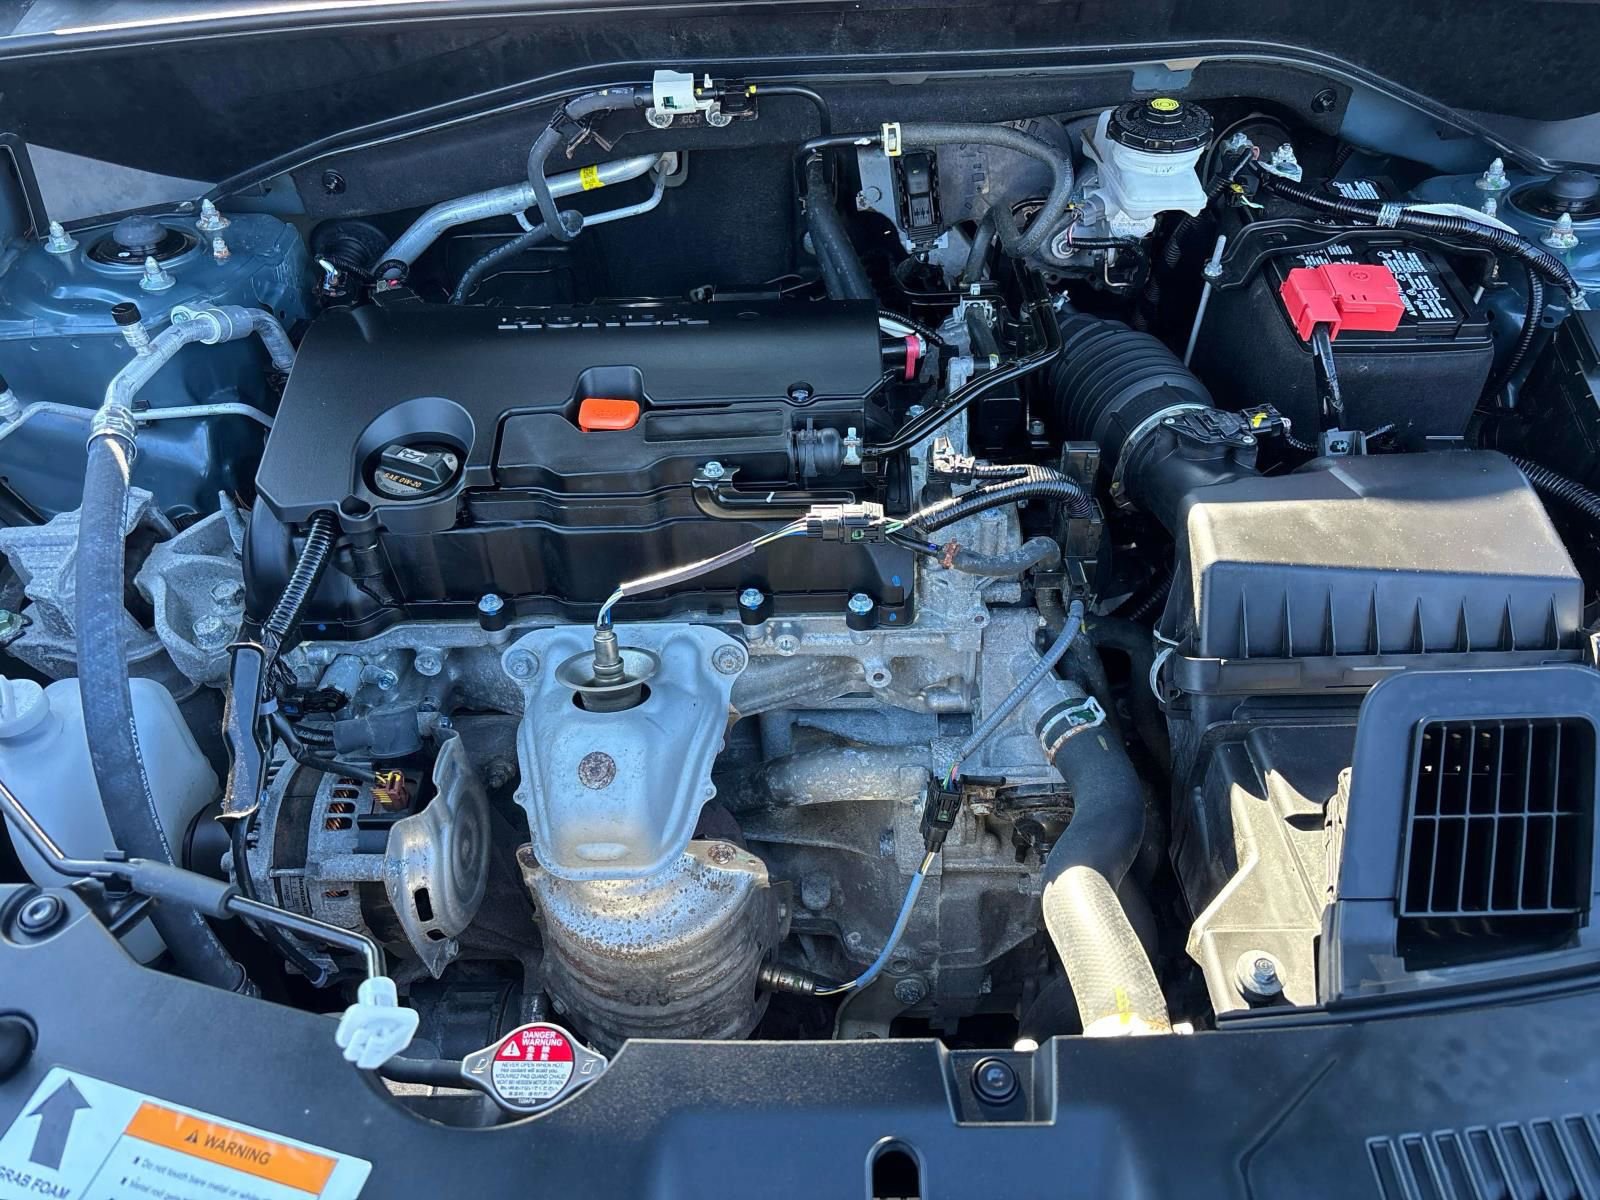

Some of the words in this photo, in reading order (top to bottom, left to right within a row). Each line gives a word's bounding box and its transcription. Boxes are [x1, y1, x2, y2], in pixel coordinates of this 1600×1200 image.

[383, 472, 399, 482] SAE
[399, 477, 422, 488] 0W-20
[522, 1031, 556, 1039] DANGER
[203, 1134, 273, 1166] WARNING
[0, 1166, 32, 1188] GRAB
[31, 1178, 71, 1200] FOAM
